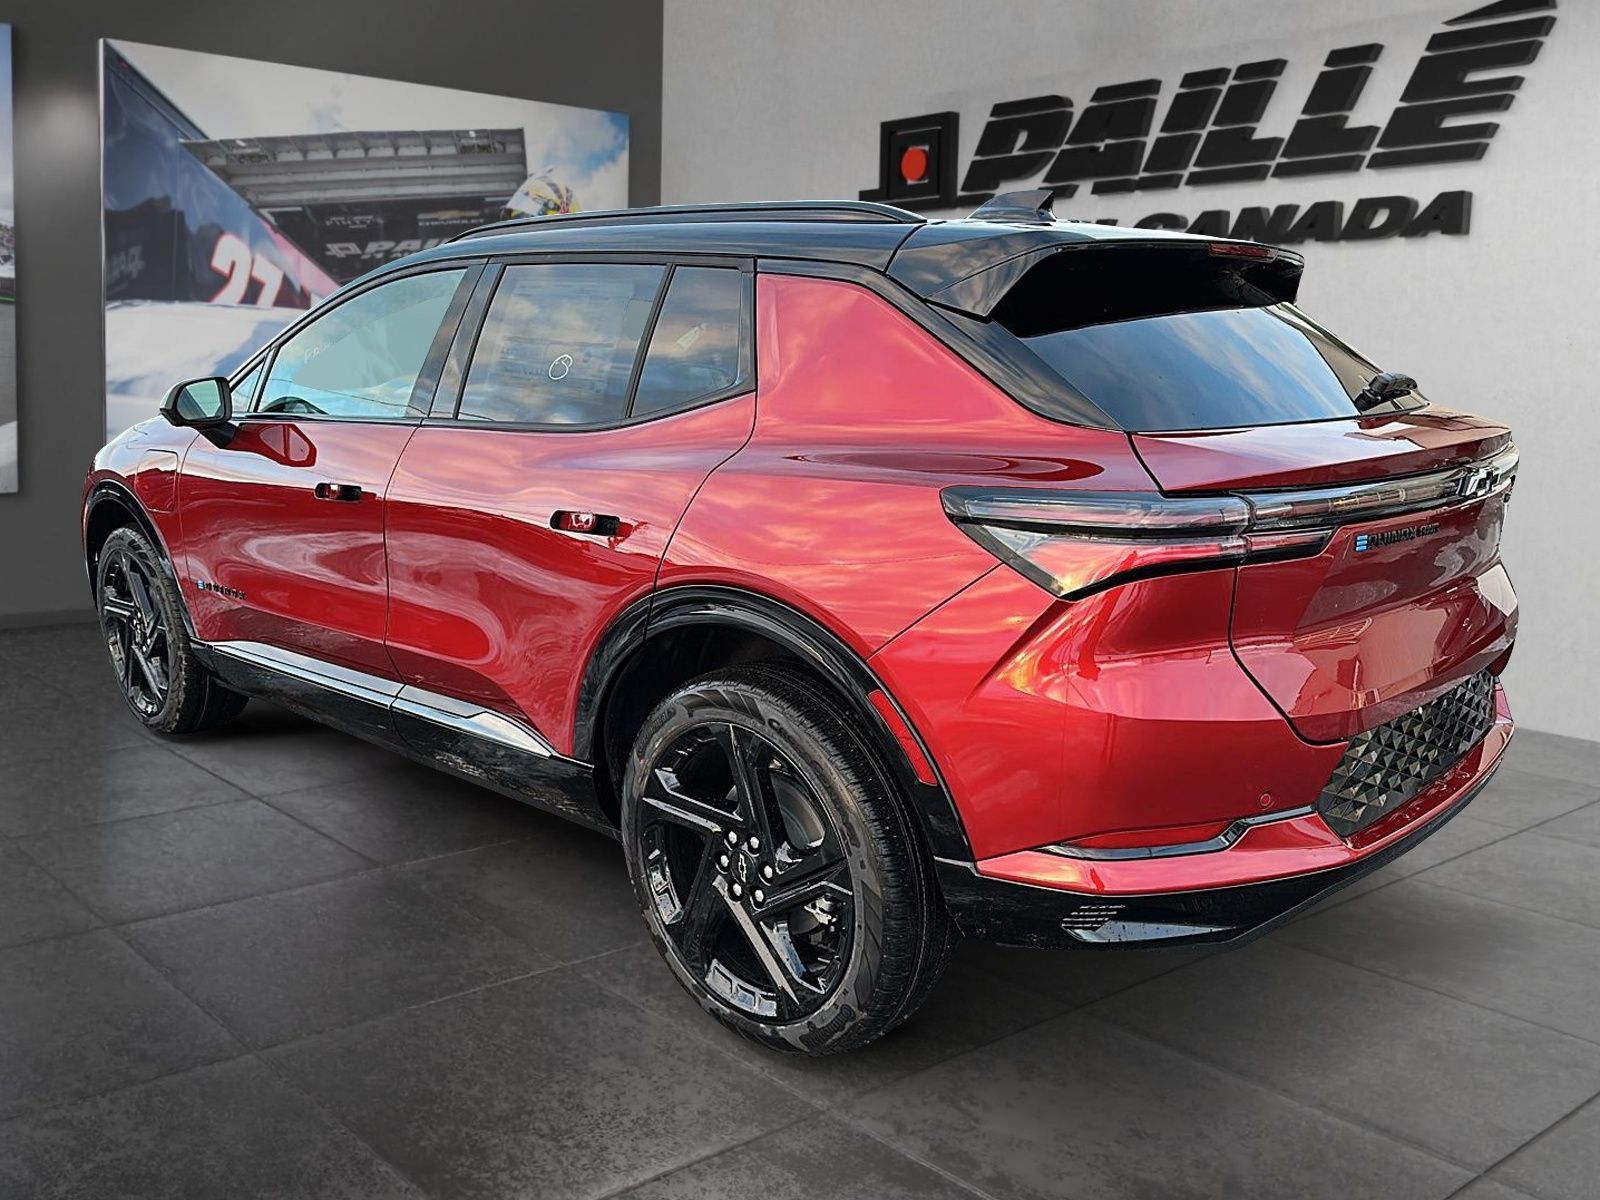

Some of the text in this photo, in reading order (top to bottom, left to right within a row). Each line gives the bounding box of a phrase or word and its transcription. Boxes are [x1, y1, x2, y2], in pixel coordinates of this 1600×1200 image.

[959, 0, 1557, 205] PAILLÉ
[1132, 190, 1473, 243] CANADA
[208, 231, 285, 308] 27
[1355, 526, 1417, 552] EQUINOX
